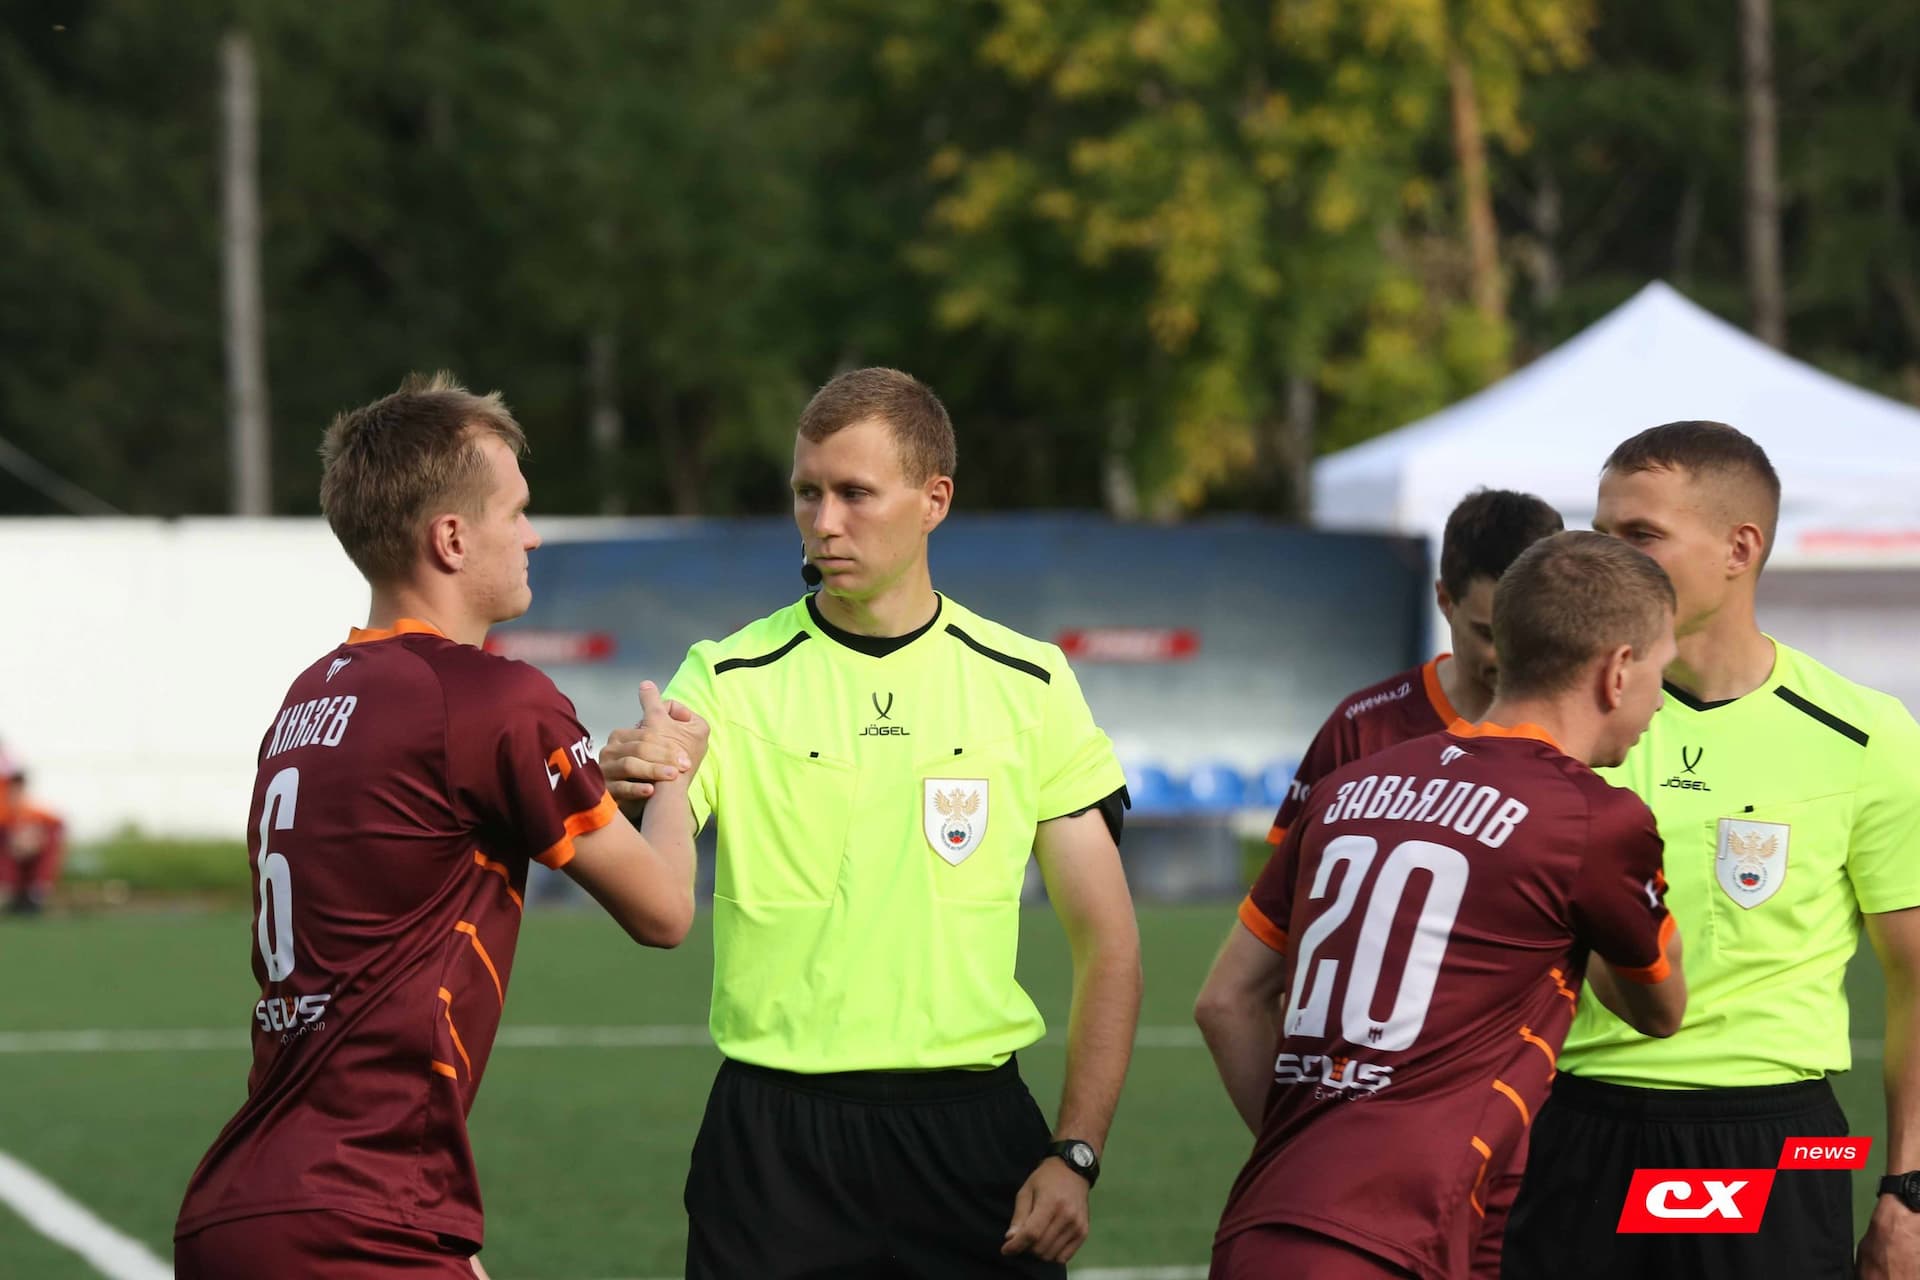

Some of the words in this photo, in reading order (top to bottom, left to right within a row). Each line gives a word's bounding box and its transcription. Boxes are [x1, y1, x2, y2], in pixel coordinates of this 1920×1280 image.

[266, 695, 358, 759] КНЯЗЕВ
[859, 724, 911, 736] JÖGEL
[1323, 775, 1529, 849] ЗАВЬЯЛОВ
[1659, 777, 1711, 791] JÖGEL
[258, 767, 300, 982] 6
[1284, 835, 1469, 1051] 20
